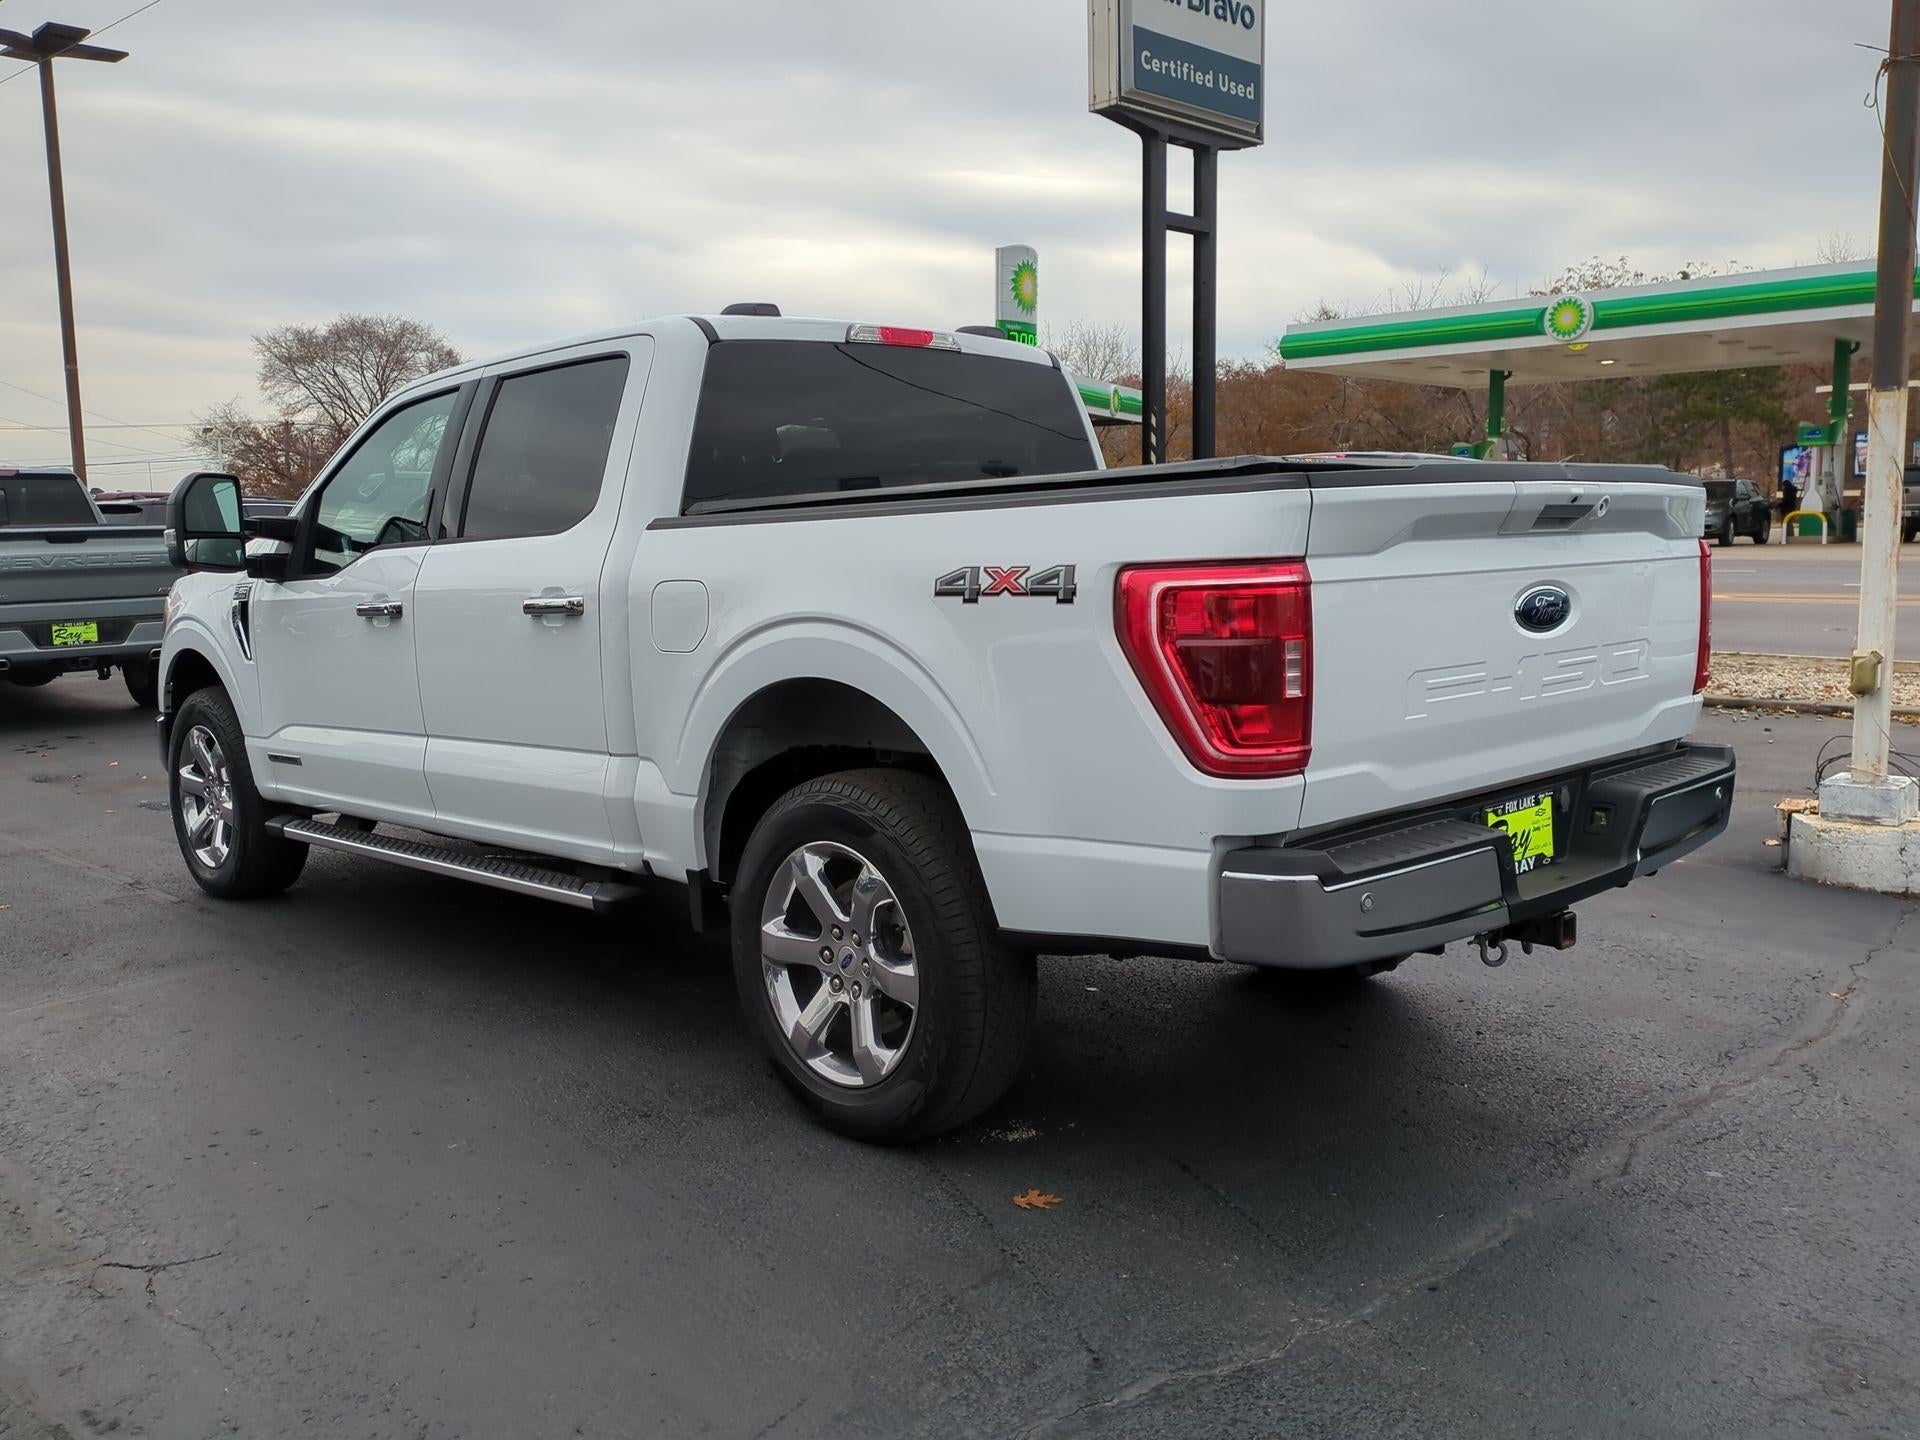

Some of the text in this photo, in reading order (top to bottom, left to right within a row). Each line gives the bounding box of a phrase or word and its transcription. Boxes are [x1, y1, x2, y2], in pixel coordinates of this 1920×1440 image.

[1141, 50, 1254, 100] Certified Used
[1532, 596, 1563, 620] Ford
[54, 628, 82, 643] Ray
[1404, 638, 1651, 720] F-150
[1505, 800, 1518, 814] FOX
[1519, 795, 1536, 810] LAKE
